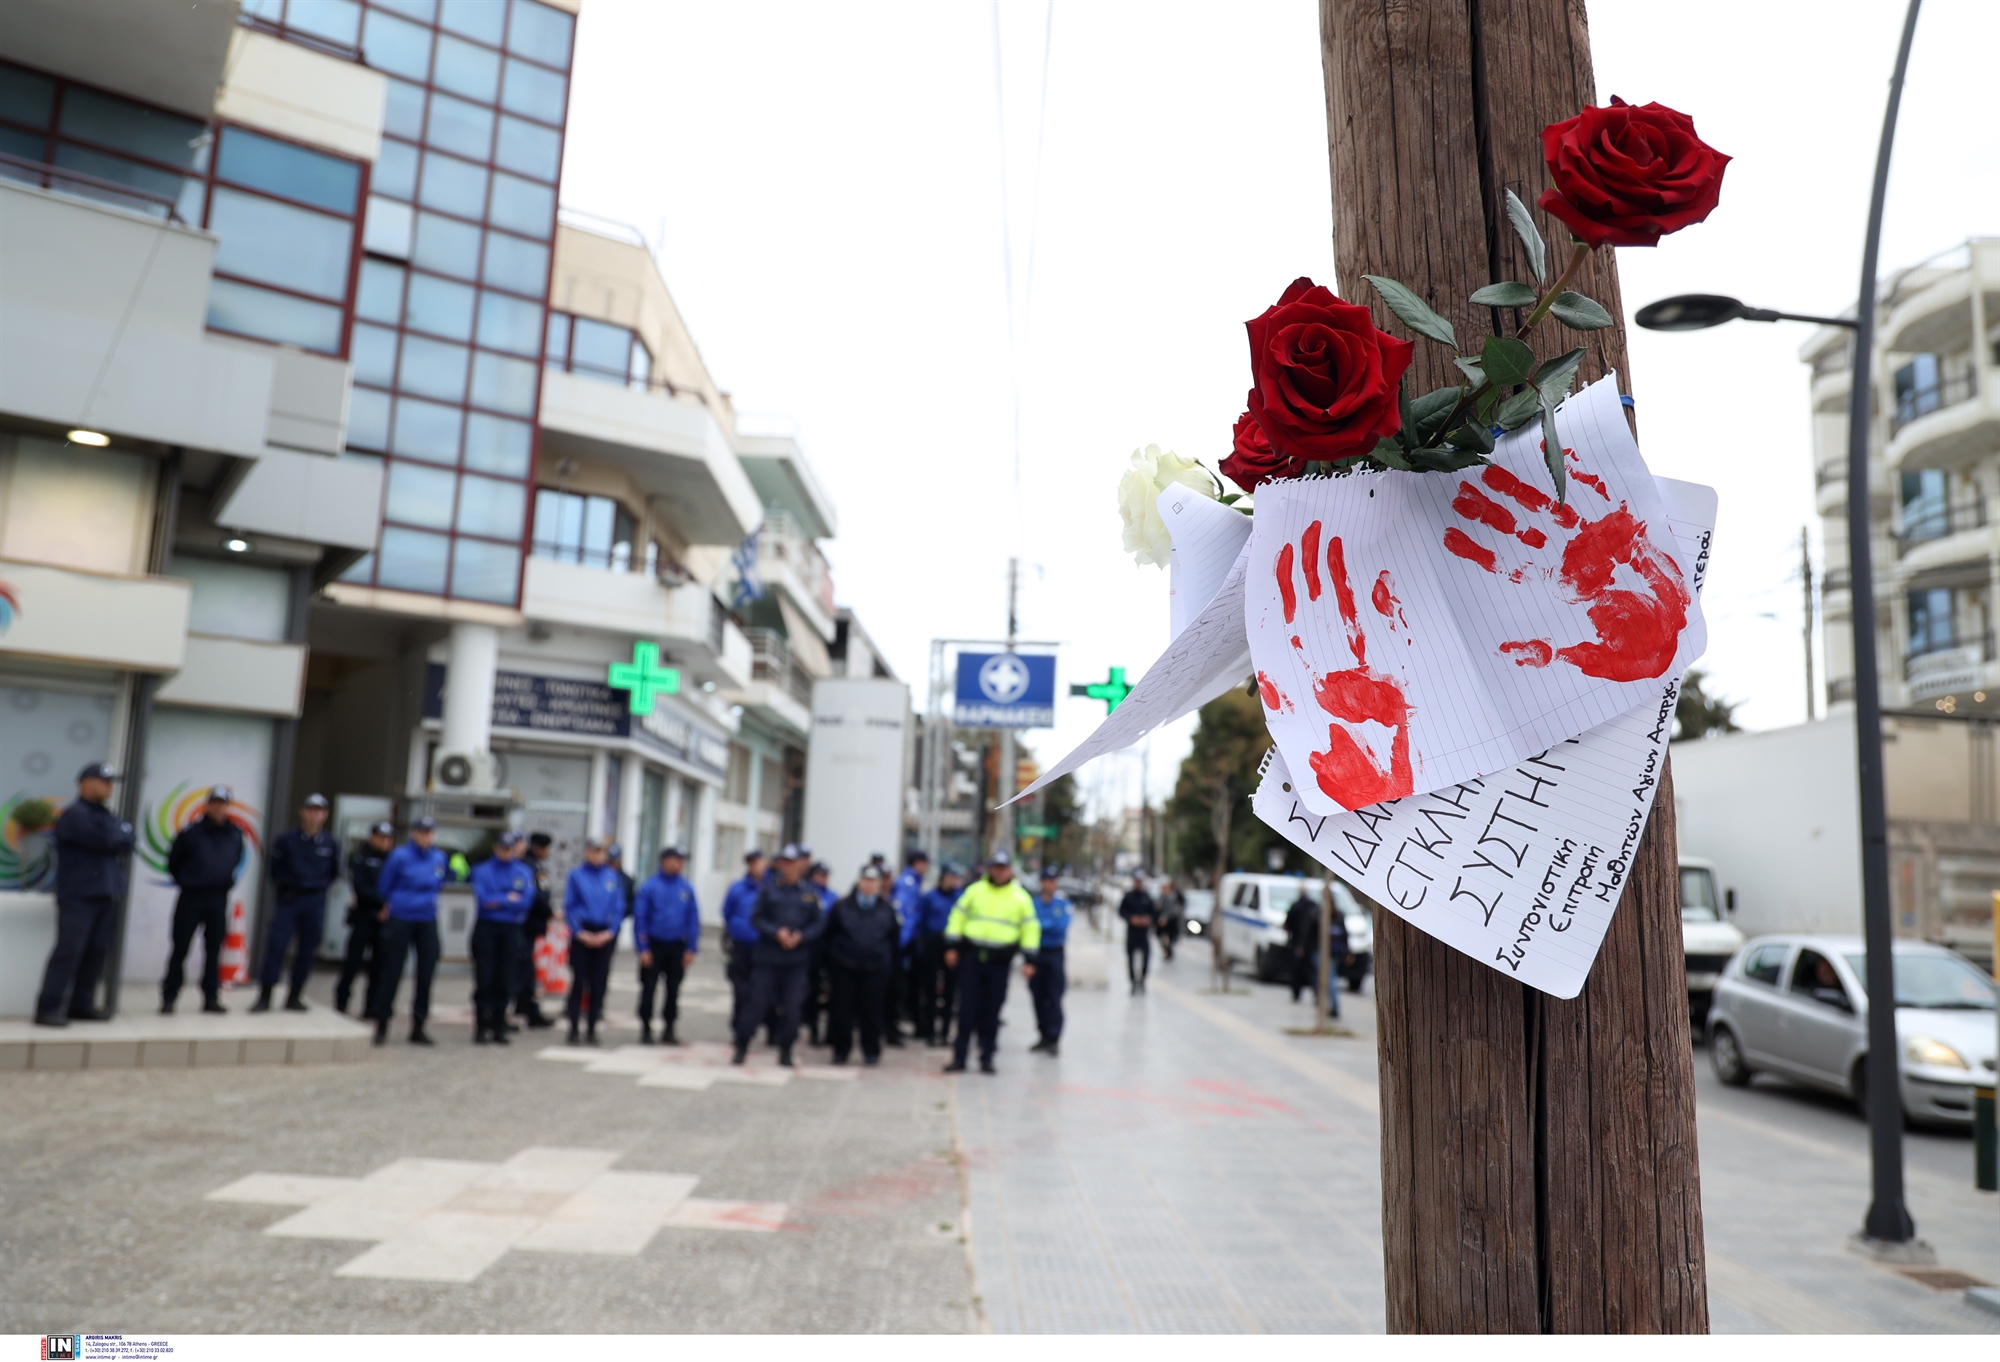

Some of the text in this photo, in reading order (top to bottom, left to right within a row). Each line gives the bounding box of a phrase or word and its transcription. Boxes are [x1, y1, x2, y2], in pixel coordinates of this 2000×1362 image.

[1386, 778, 1485, 910] ΕΓΚΛΗ
[1595, 808, 1642, 902] Μαθητών
[1632, 748, 1658, 802] Αγίων
[1647, 677, 1679, 744] Αναργύ
[1496, 837, 1578, 971] Συντονιστική
[1549, 843, 1605, 932] Επιτροπή
